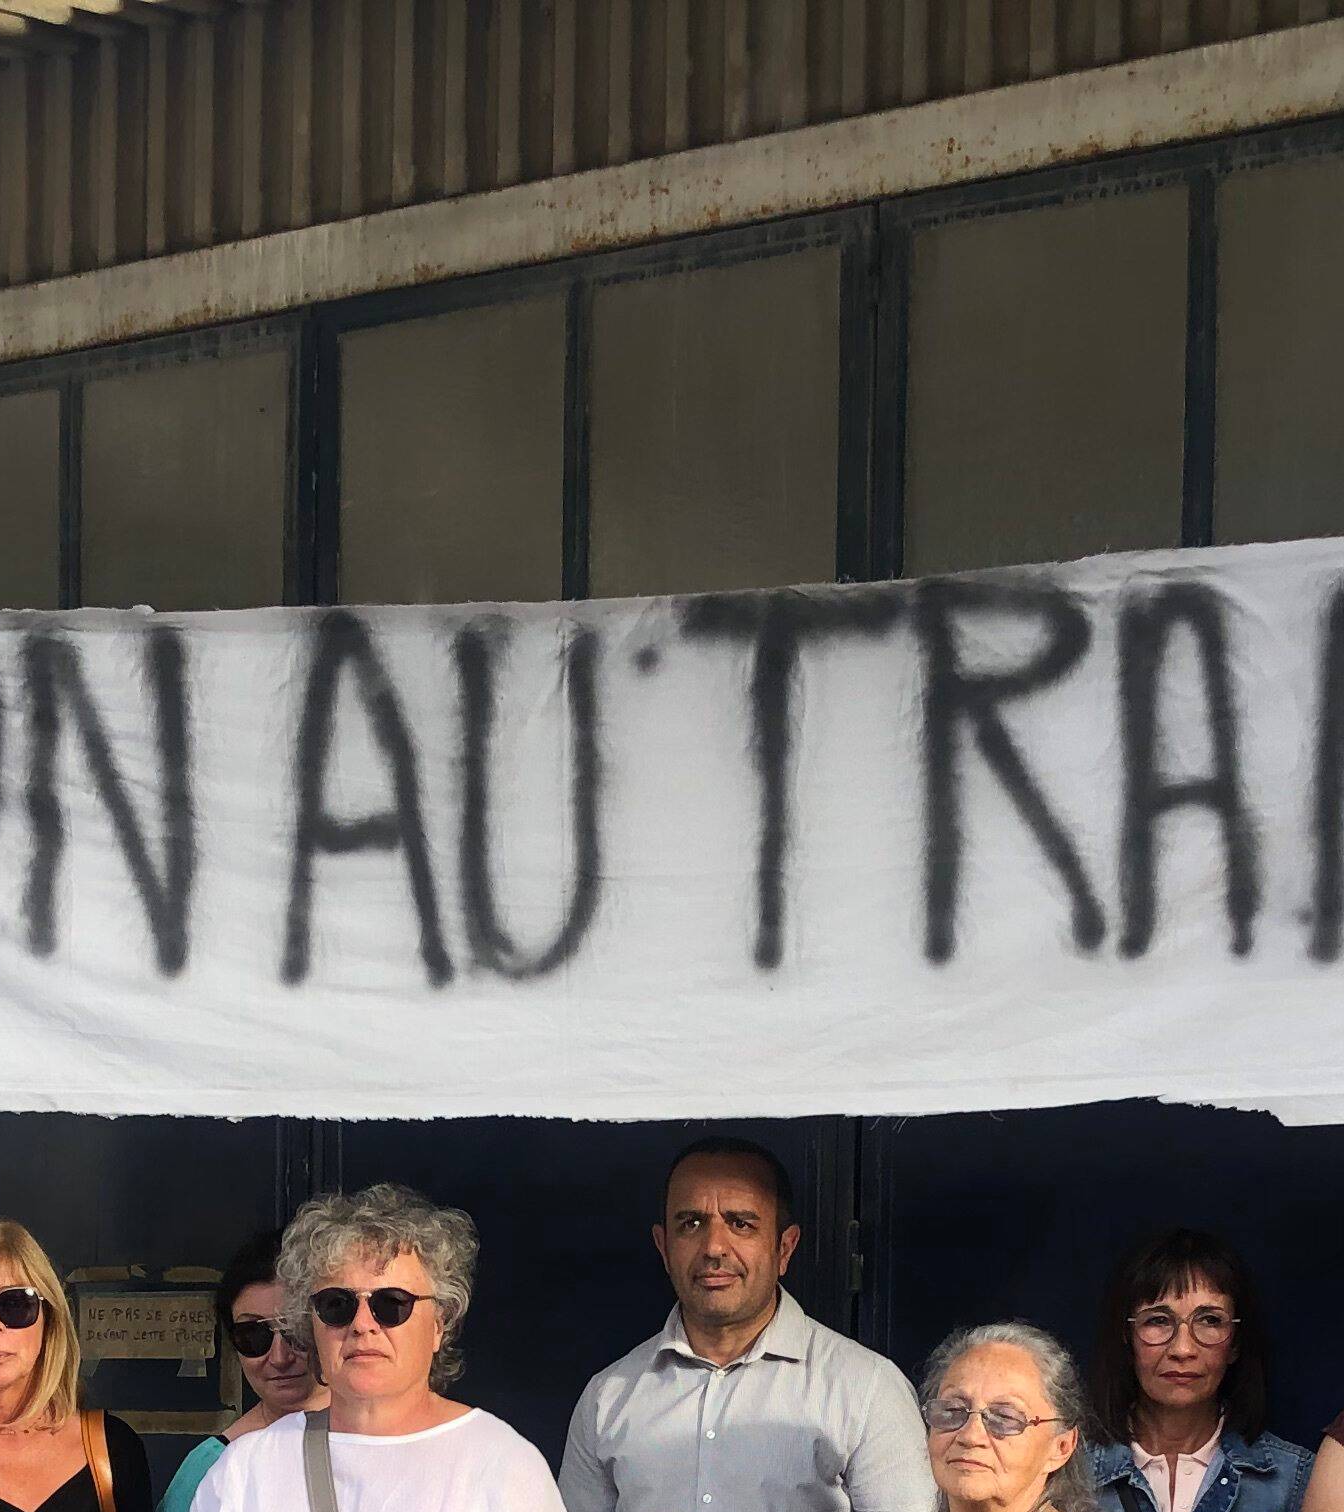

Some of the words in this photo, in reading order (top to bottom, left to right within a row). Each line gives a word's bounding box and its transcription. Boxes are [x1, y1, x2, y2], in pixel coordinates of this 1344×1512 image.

[278, 606, 606, 990] AU
[88, 1308, 105, 1321] NE
[111, 1307, 140, 1322] PAS
